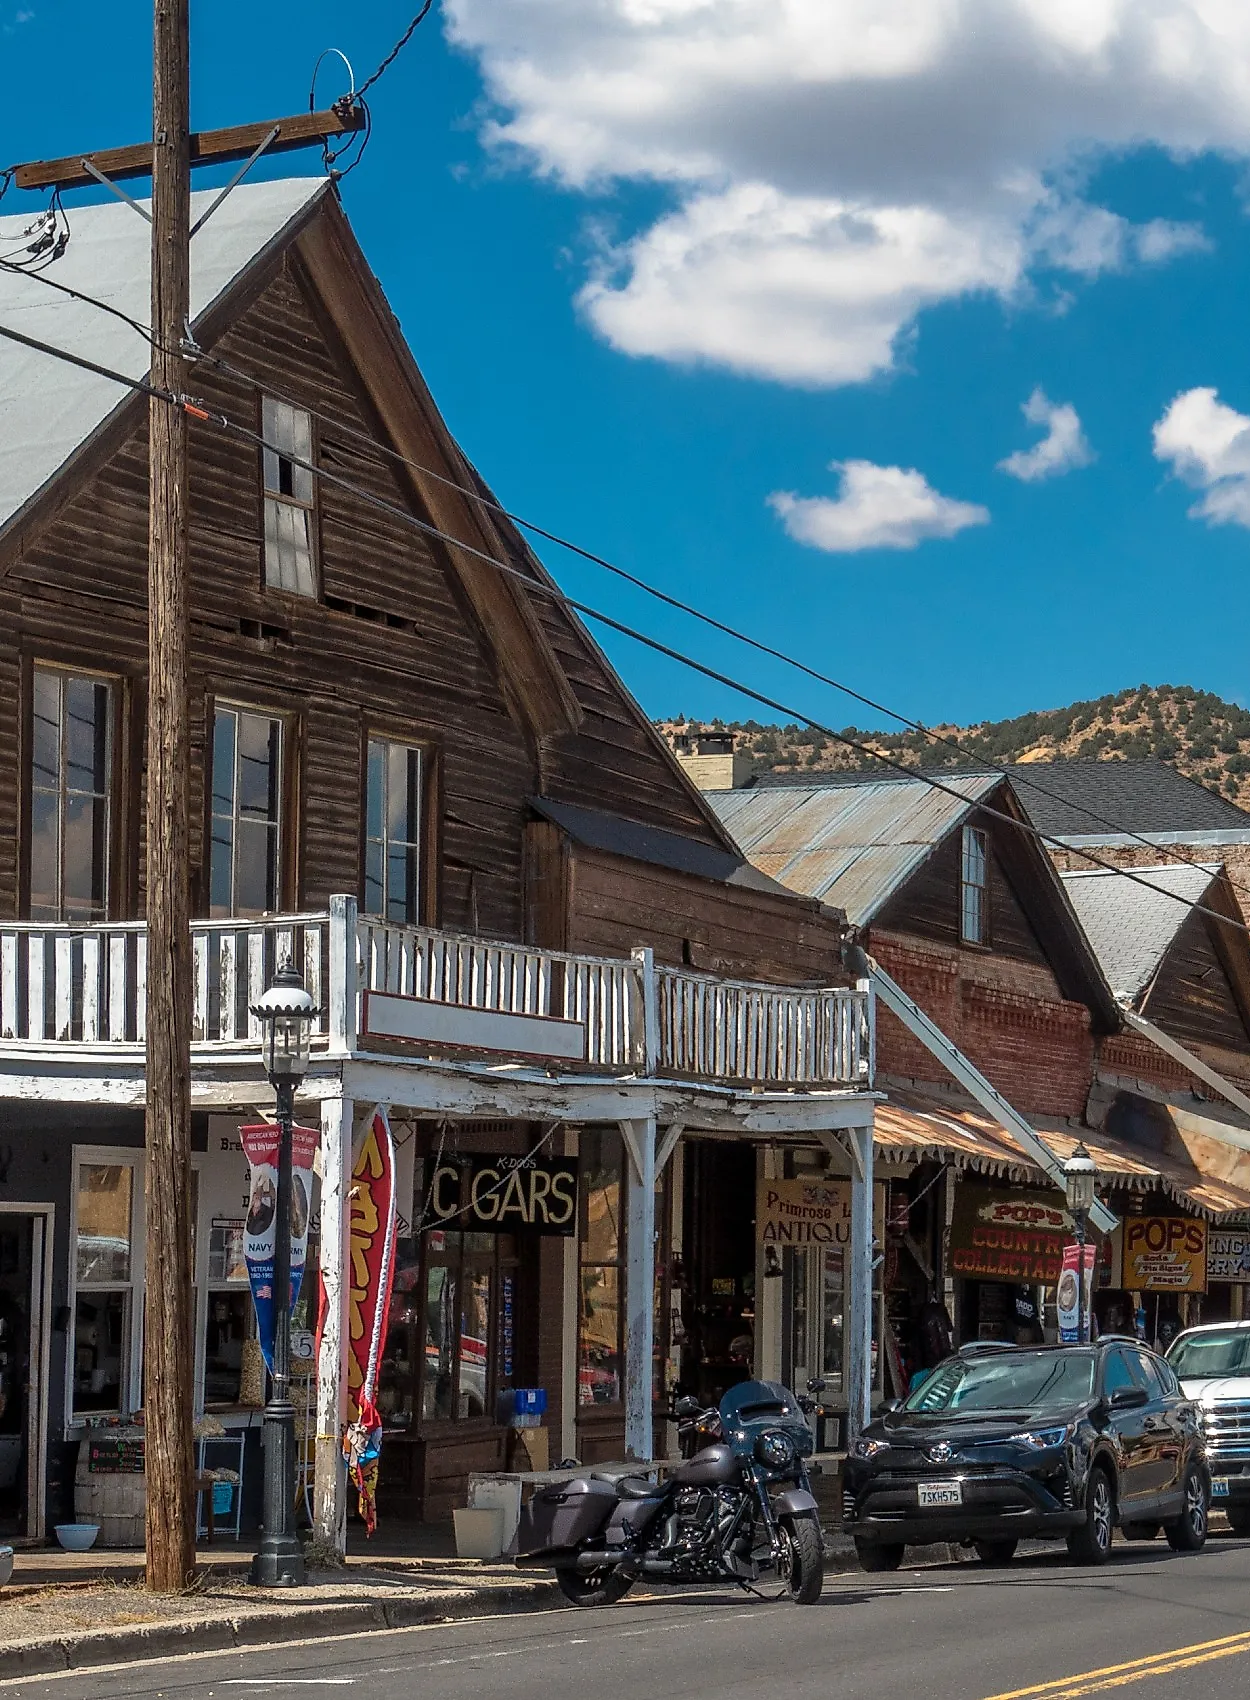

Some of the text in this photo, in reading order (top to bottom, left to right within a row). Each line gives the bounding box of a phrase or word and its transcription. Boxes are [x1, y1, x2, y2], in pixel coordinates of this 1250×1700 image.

[433, 1167, 575, 1224] CGARS
[767, 1191, 831, 1219] Primrose
[763, 1220, 851, 1242] ANTIQU
[1127, 1218, 1204, 1254] POPS
[248, 1243, 273, 1252] NAVY
[953, 1250, 1062, 1280] COLLECTAB
[1153, 1276, 1183, 1285] Magic
[921, 1490, 959, 1503] 7SKH575
